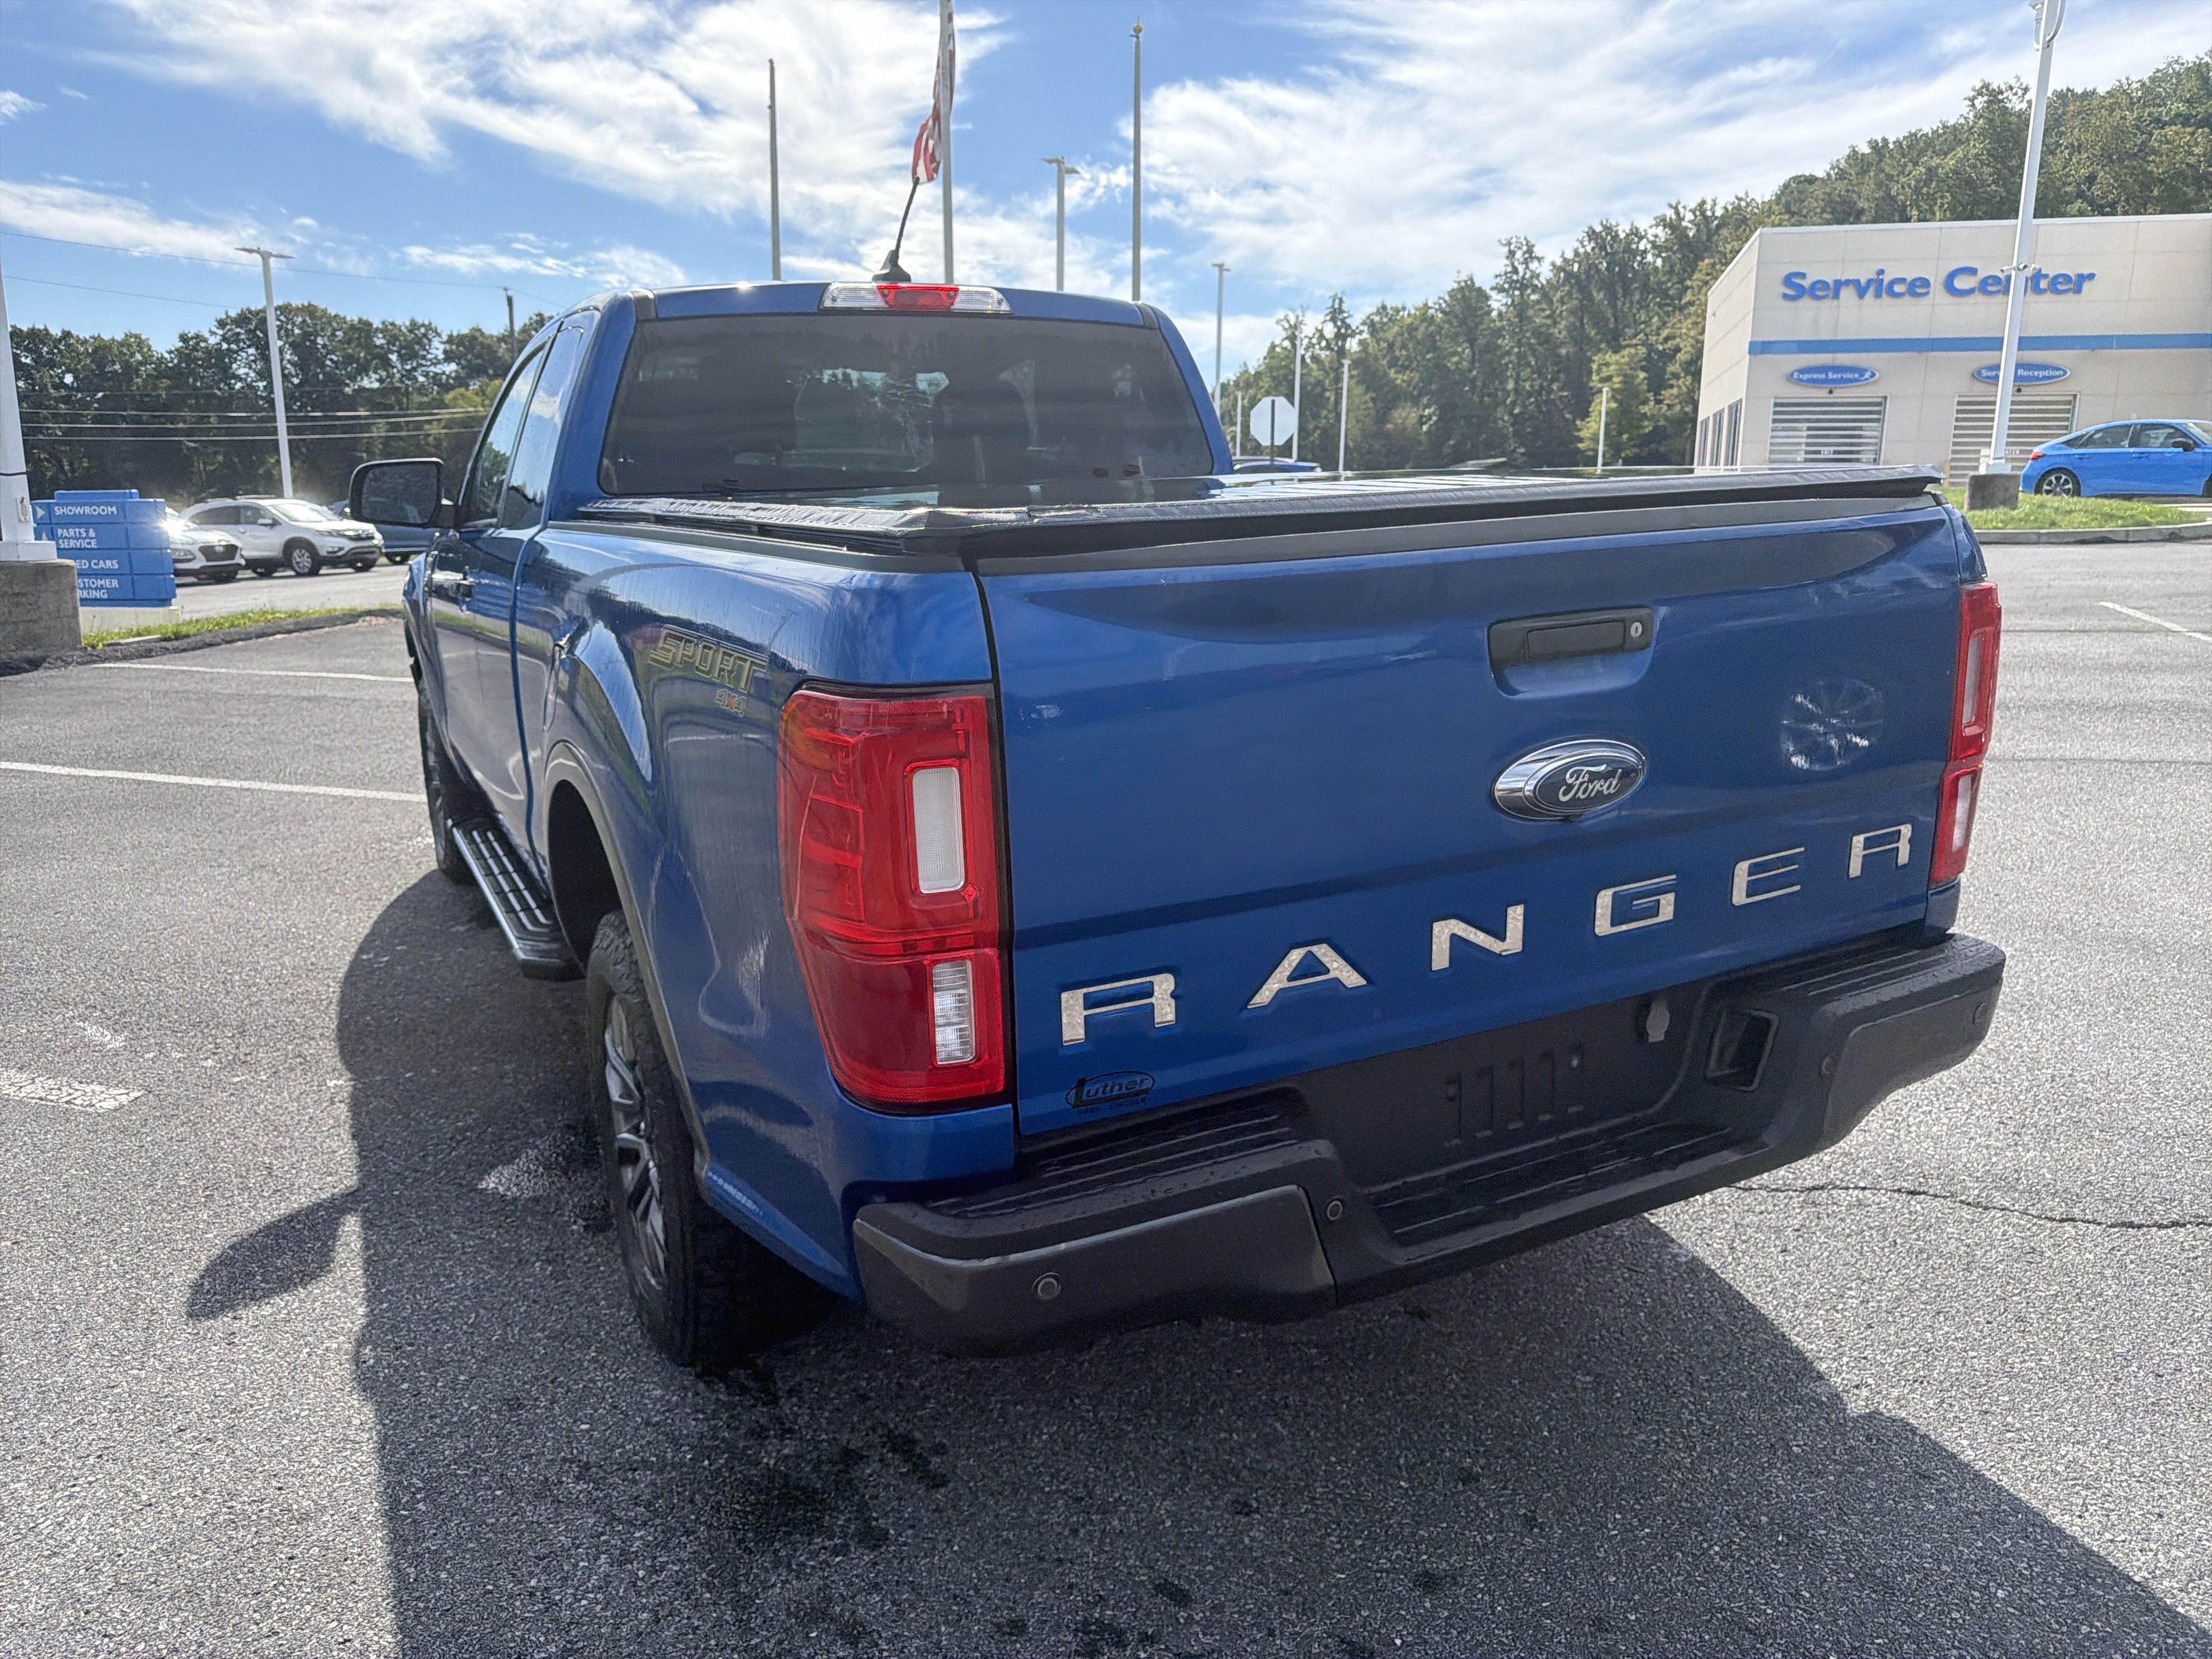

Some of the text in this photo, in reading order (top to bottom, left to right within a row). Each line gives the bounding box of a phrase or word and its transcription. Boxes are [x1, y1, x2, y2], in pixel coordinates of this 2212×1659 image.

[1781, 268, 1931, 301] Service
[1793, 371, 1859, 381] Express Service
[1981, 369, 2064, 378] Serv Reception
[54, 506, 117, 515] SHOWROOM
[57, 528, 96, 538] PARTS &
[58, 539, 98, 549] SERVICE
[76, 560, 119, 569] ED CARS
[78, 578, 119, 588] STOMER
[78, 589, 108, 599] RKING
[647, 624, 769, 693] SPORT
[1558, 764, 1622, 802] Ford
[1060, 823, 1912, 1046] RANGER
[1072, 1077, 1150, 1108] Luther
